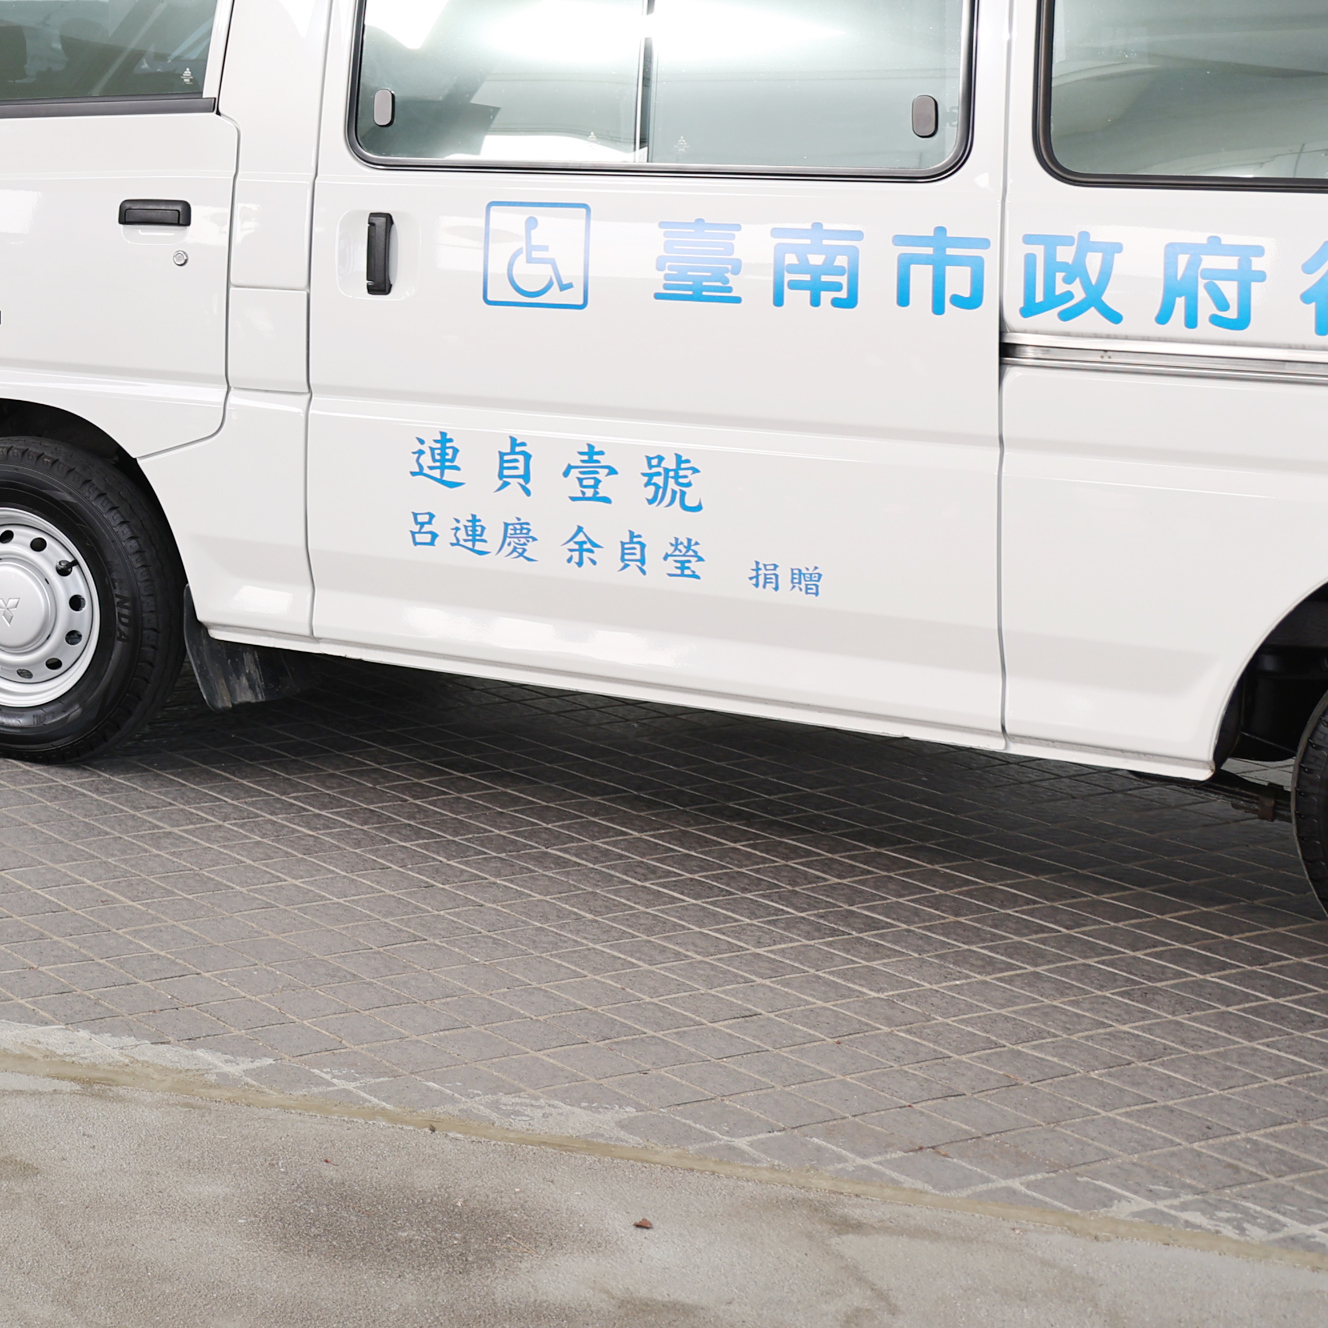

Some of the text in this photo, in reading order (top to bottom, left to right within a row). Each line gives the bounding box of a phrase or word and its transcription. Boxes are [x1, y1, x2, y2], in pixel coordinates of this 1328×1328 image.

[409, 431, 704, 514] 連貞壹號
[409, 510, 824, 597] 呂連慶 余貞瑩 捐贈
